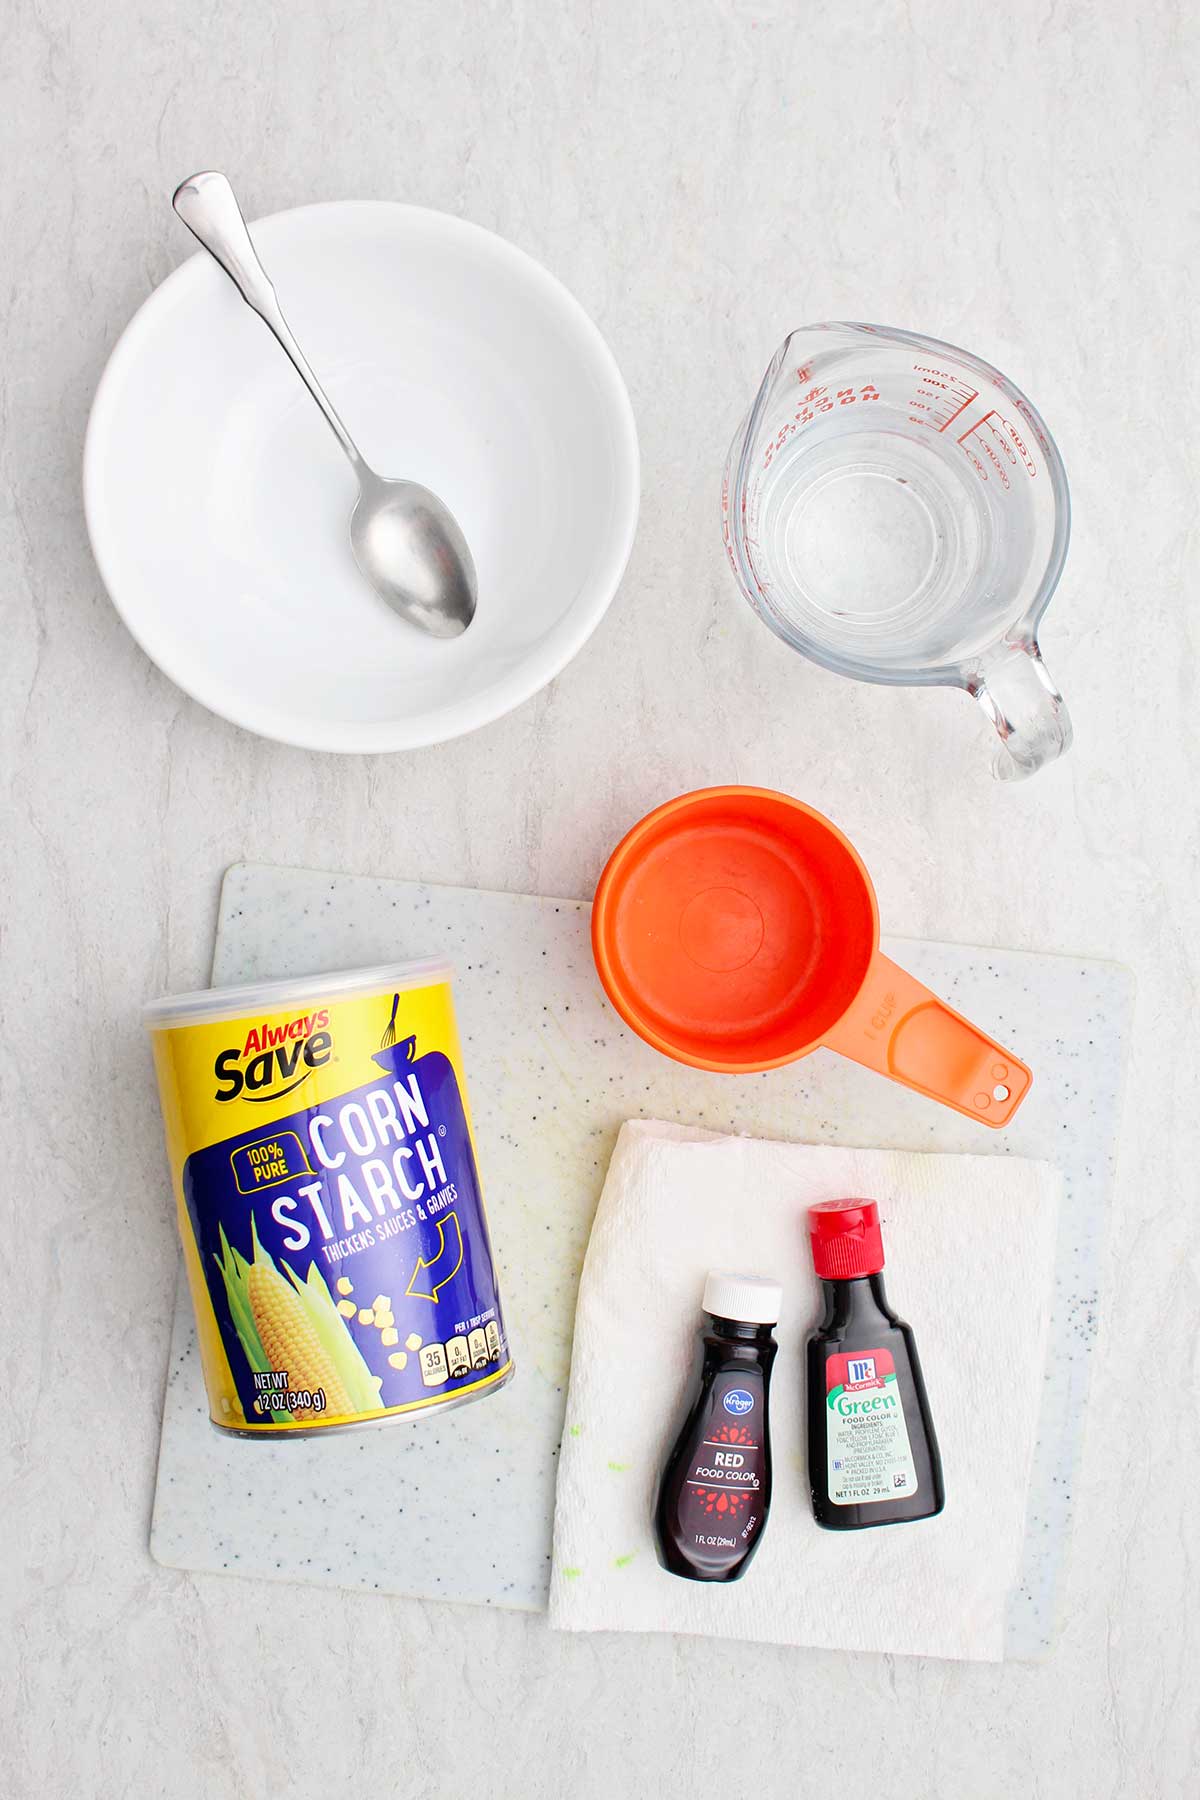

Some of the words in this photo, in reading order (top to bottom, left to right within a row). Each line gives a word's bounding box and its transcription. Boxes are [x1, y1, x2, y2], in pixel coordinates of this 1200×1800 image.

[243, 1009, 329, 1058] Always
[214, 1031, 331, 1102] Save
[308, 1073, 429, 1170] CORN
[247, 1142, 283, 1166] 100%
[253, 1159, 289, 1182] PURE
[271, 1133, 448, 1251] STARCH
[322, 1229, 376, 1264] THICKENS
[376, 1209, 416, 1241] SAUCES
[416, 1204, 428, 1221] &
[426, 1183, 458, 1215] GRAVIES
[426, 1351, 441, 1368] 35
[254, 1373, 271, 1389] NET
[271, 1372, 288, 1389] WT
[257, 1394, 270, 1410] 12
[271, 1393, 286, 1410] OZ
[726, 1394, 752, 1411] Kroger
[838, 1395, 896, 1416] Green
[842, 1416, 865, 1424] FOOD
[866, 1413, 891, 1421] COLOR
[714, 1452, 745, 1468] RED
[695, 1467, 724, 1479] FOOD
[725, 1471, 756, 1481] COLOR
[860, 1488, 870, 1496] OZ
